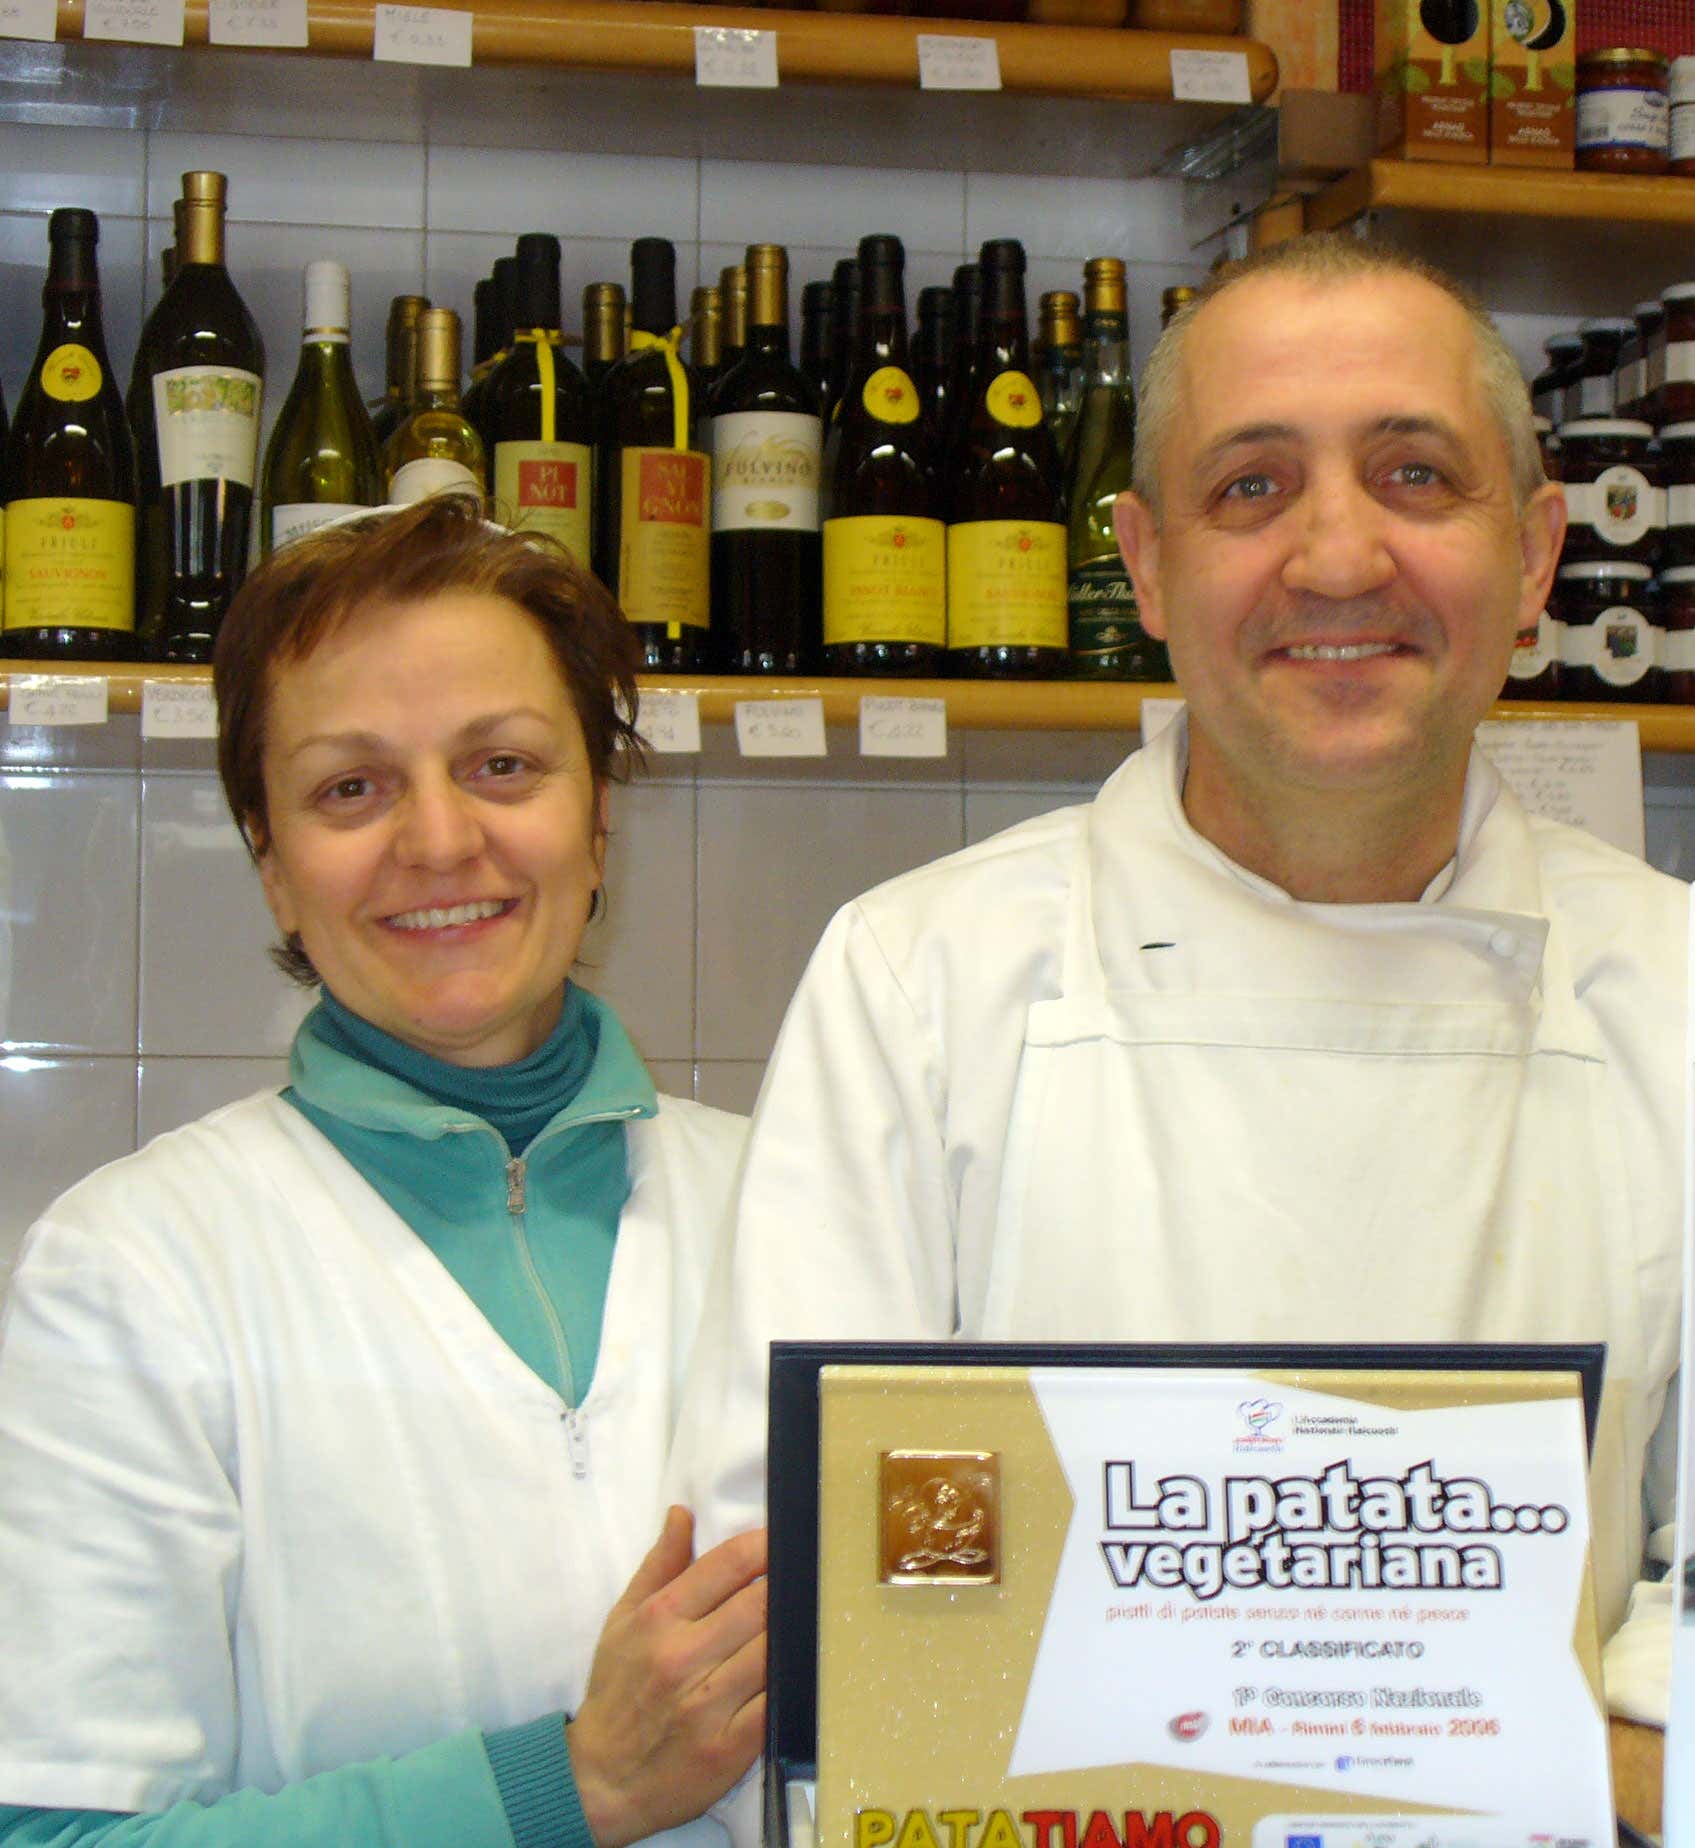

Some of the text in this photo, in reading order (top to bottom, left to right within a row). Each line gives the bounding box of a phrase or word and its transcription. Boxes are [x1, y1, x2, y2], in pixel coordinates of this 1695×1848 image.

[1104, 1458, 1569, 1545] La patata...
[1100, 1531, 1504, 1600] vegetariana
[1157, 1602, 1173, 1619] di
[1260, 1640, 1424, 1658] CLASSIFICATO
[1262, 1687, 1367, 1708] Concorso
[1371, 1687, 1482, 1708] Nazionale
[857, 1809, 1222, 1848] PATATIAMO
